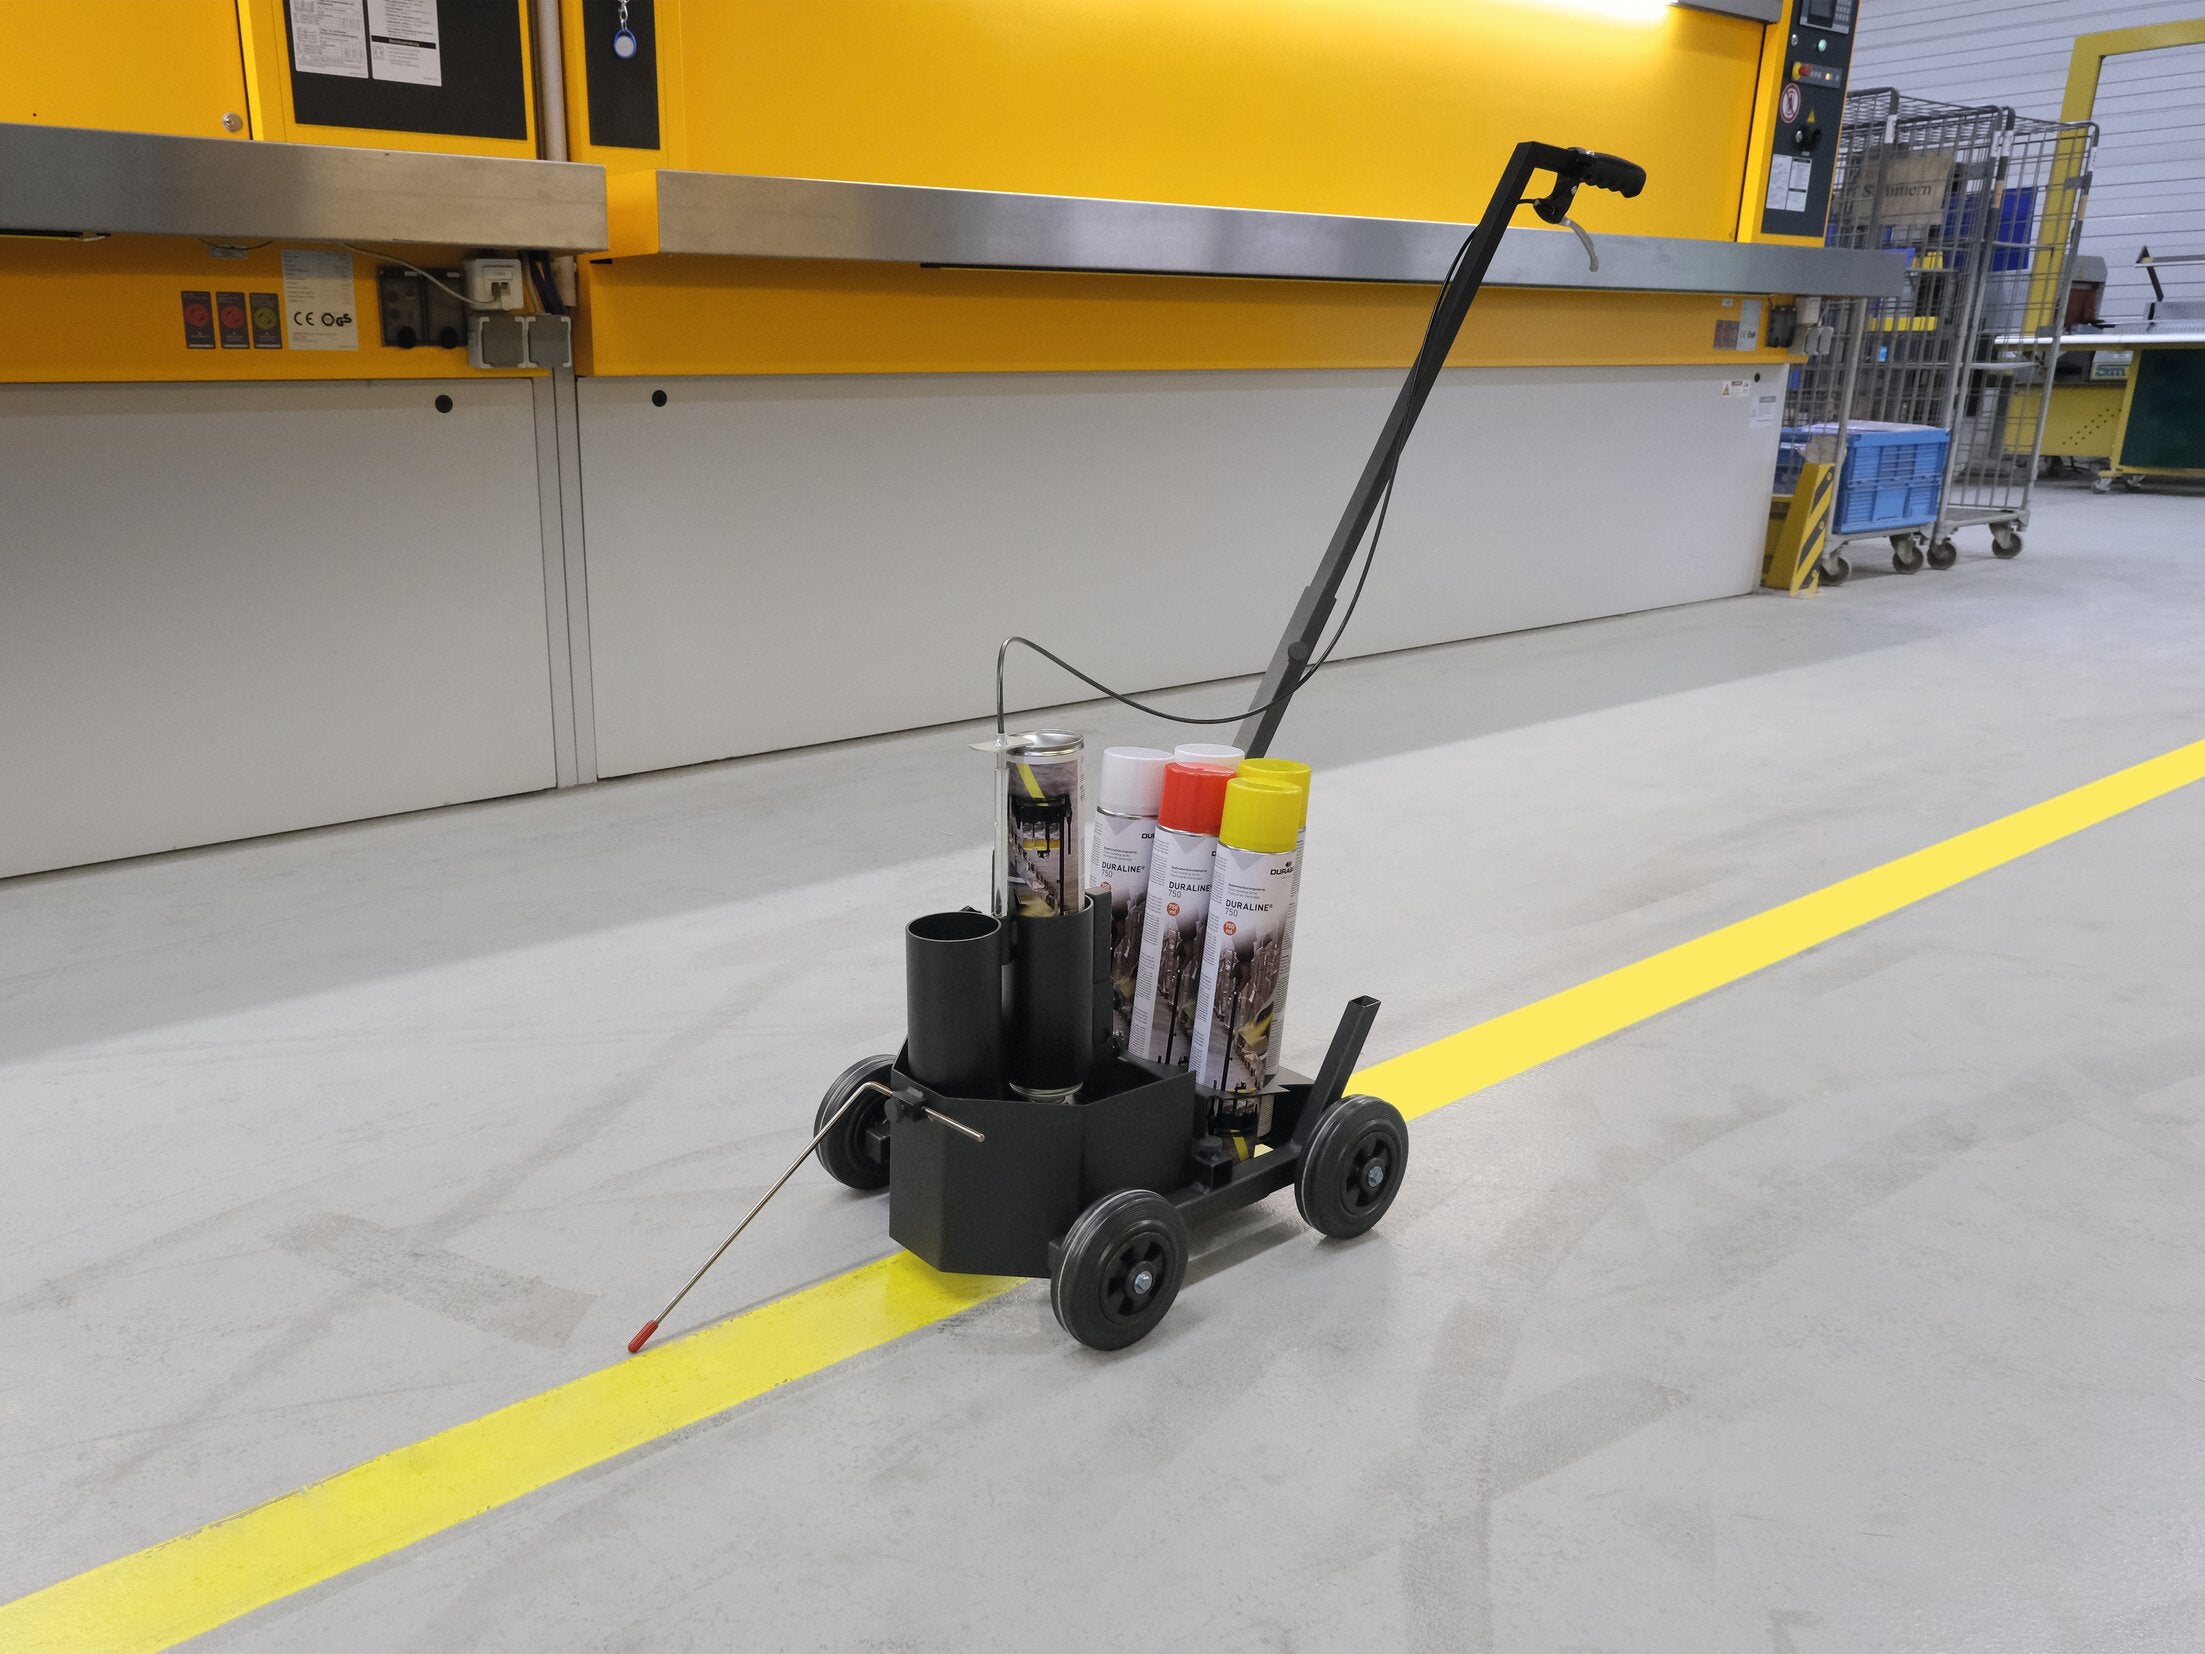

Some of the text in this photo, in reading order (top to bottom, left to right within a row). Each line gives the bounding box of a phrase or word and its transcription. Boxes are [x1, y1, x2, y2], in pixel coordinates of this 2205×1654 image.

[1101, 869, 1113, 878] 750
[1168, 889, 1182, 898] 750
[1224, 907, 1238, 917] 750
